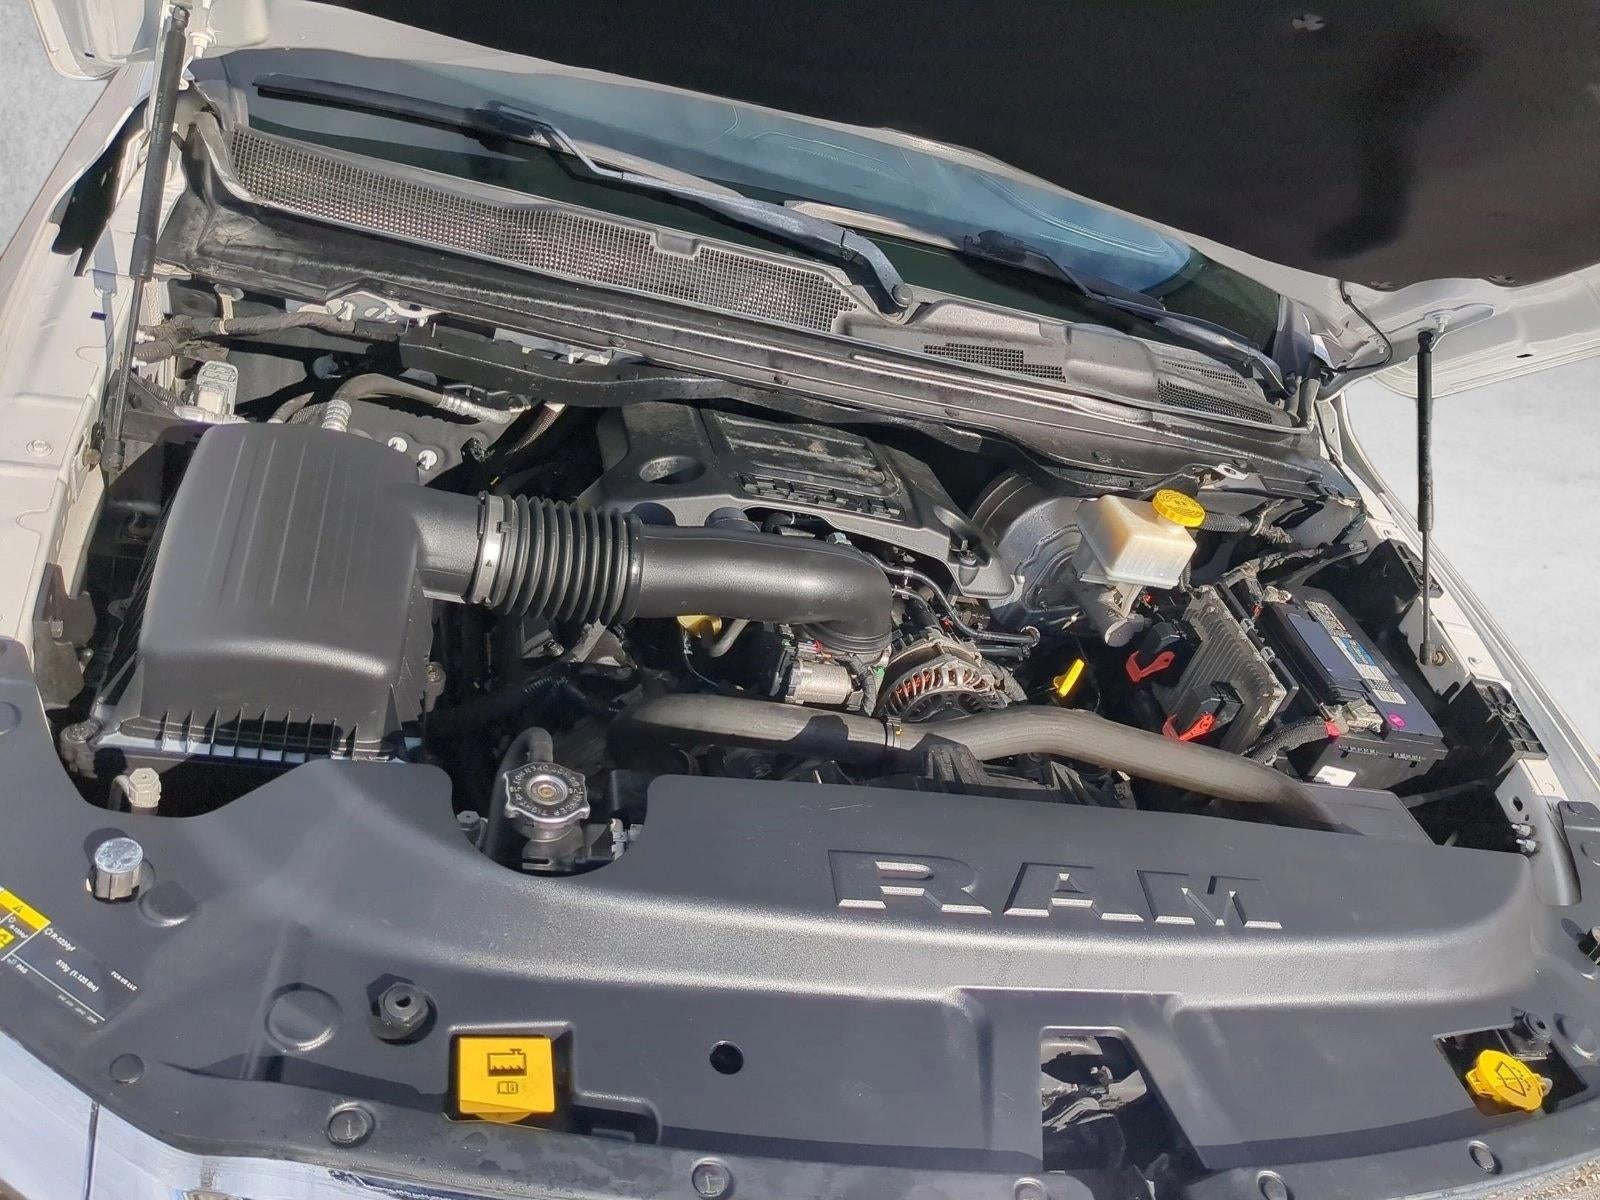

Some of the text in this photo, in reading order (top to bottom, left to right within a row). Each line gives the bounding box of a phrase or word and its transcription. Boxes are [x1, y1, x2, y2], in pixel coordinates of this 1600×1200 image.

[828, 849, 1283, 929] RAM
[50, 932, 76, 952] R-1234yf
[110, 971, 122, 981] FCA
[126, 981, 138, 991] LLC
